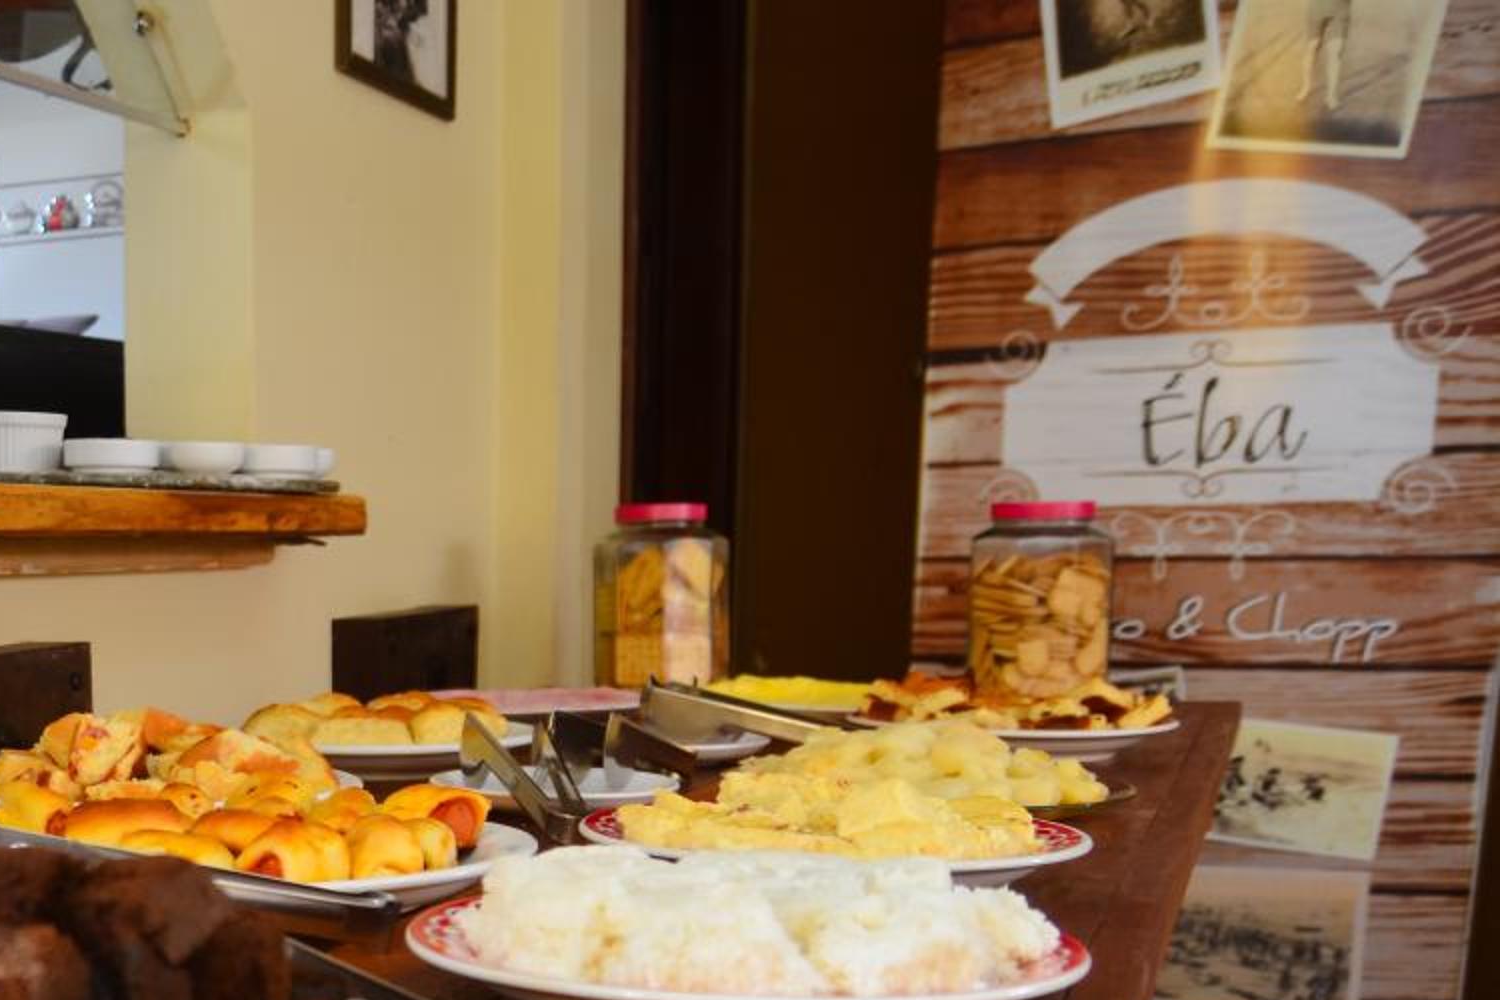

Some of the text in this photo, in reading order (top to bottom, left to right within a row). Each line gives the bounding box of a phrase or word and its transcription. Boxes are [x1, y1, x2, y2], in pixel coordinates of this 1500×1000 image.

[1141, 372, 1308, 468] Éba
[1167, 592, 1398, 663] & Chopp
